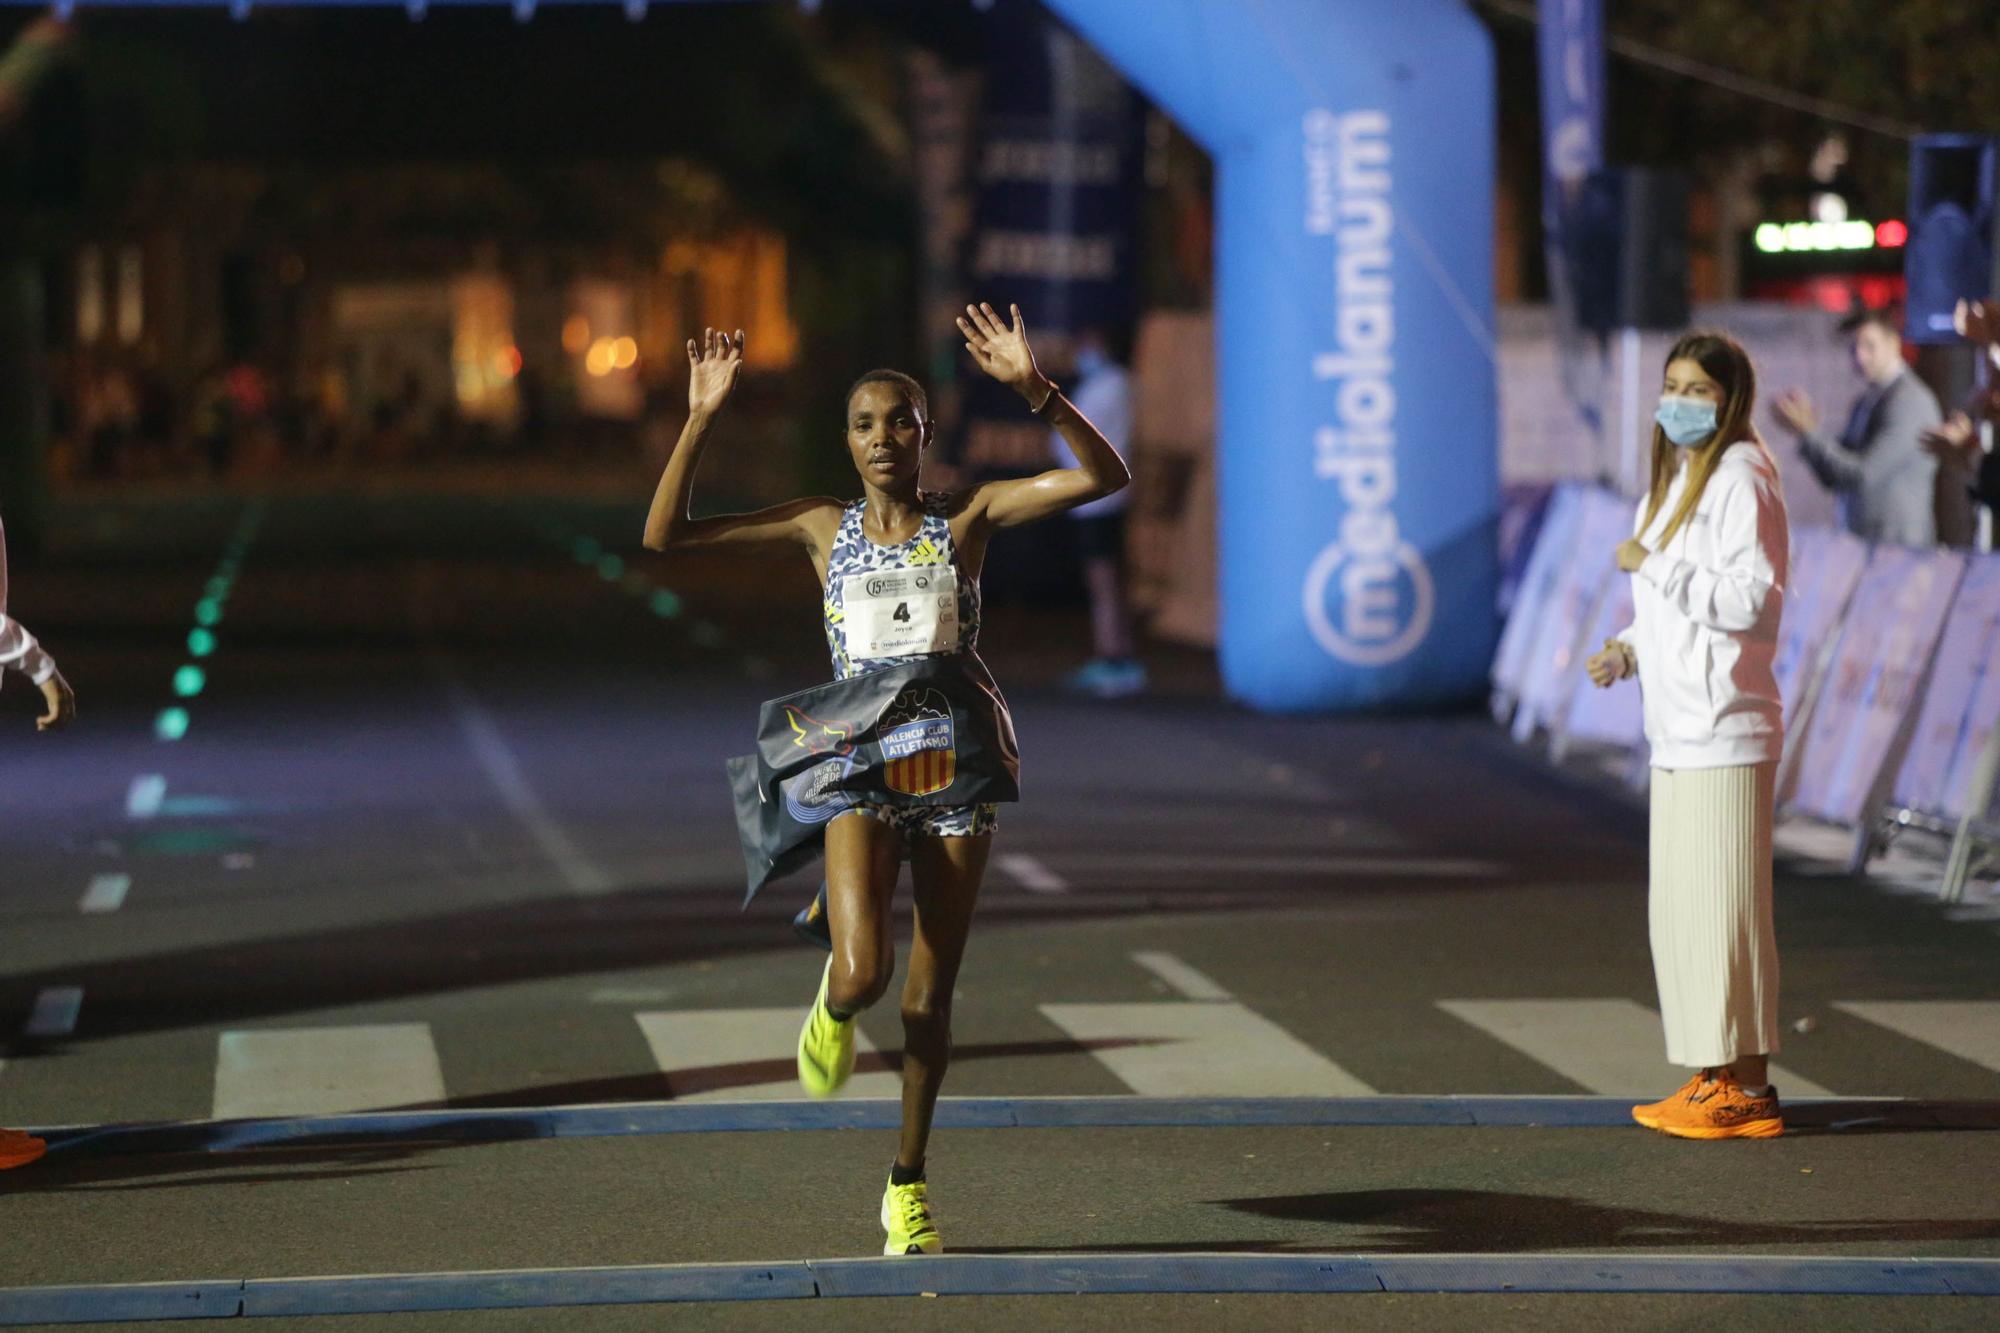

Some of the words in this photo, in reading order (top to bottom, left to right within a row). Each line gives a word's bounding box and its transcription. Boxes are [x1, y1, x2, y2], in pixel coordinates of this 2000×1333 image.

[1314, 108, 1400, 640] mediolanum
[892, 601, 911, 623] 4
[883, 727, 926, 745] VALENCIA
[927, 723, 950, 736] CLUB
[889, 736, 949, 756] ATLETISMO
[813, 762, 841, 778] VALENCIA
[813, 772, 829, 786] CLUB
[829, 772, 841, 782] DE
